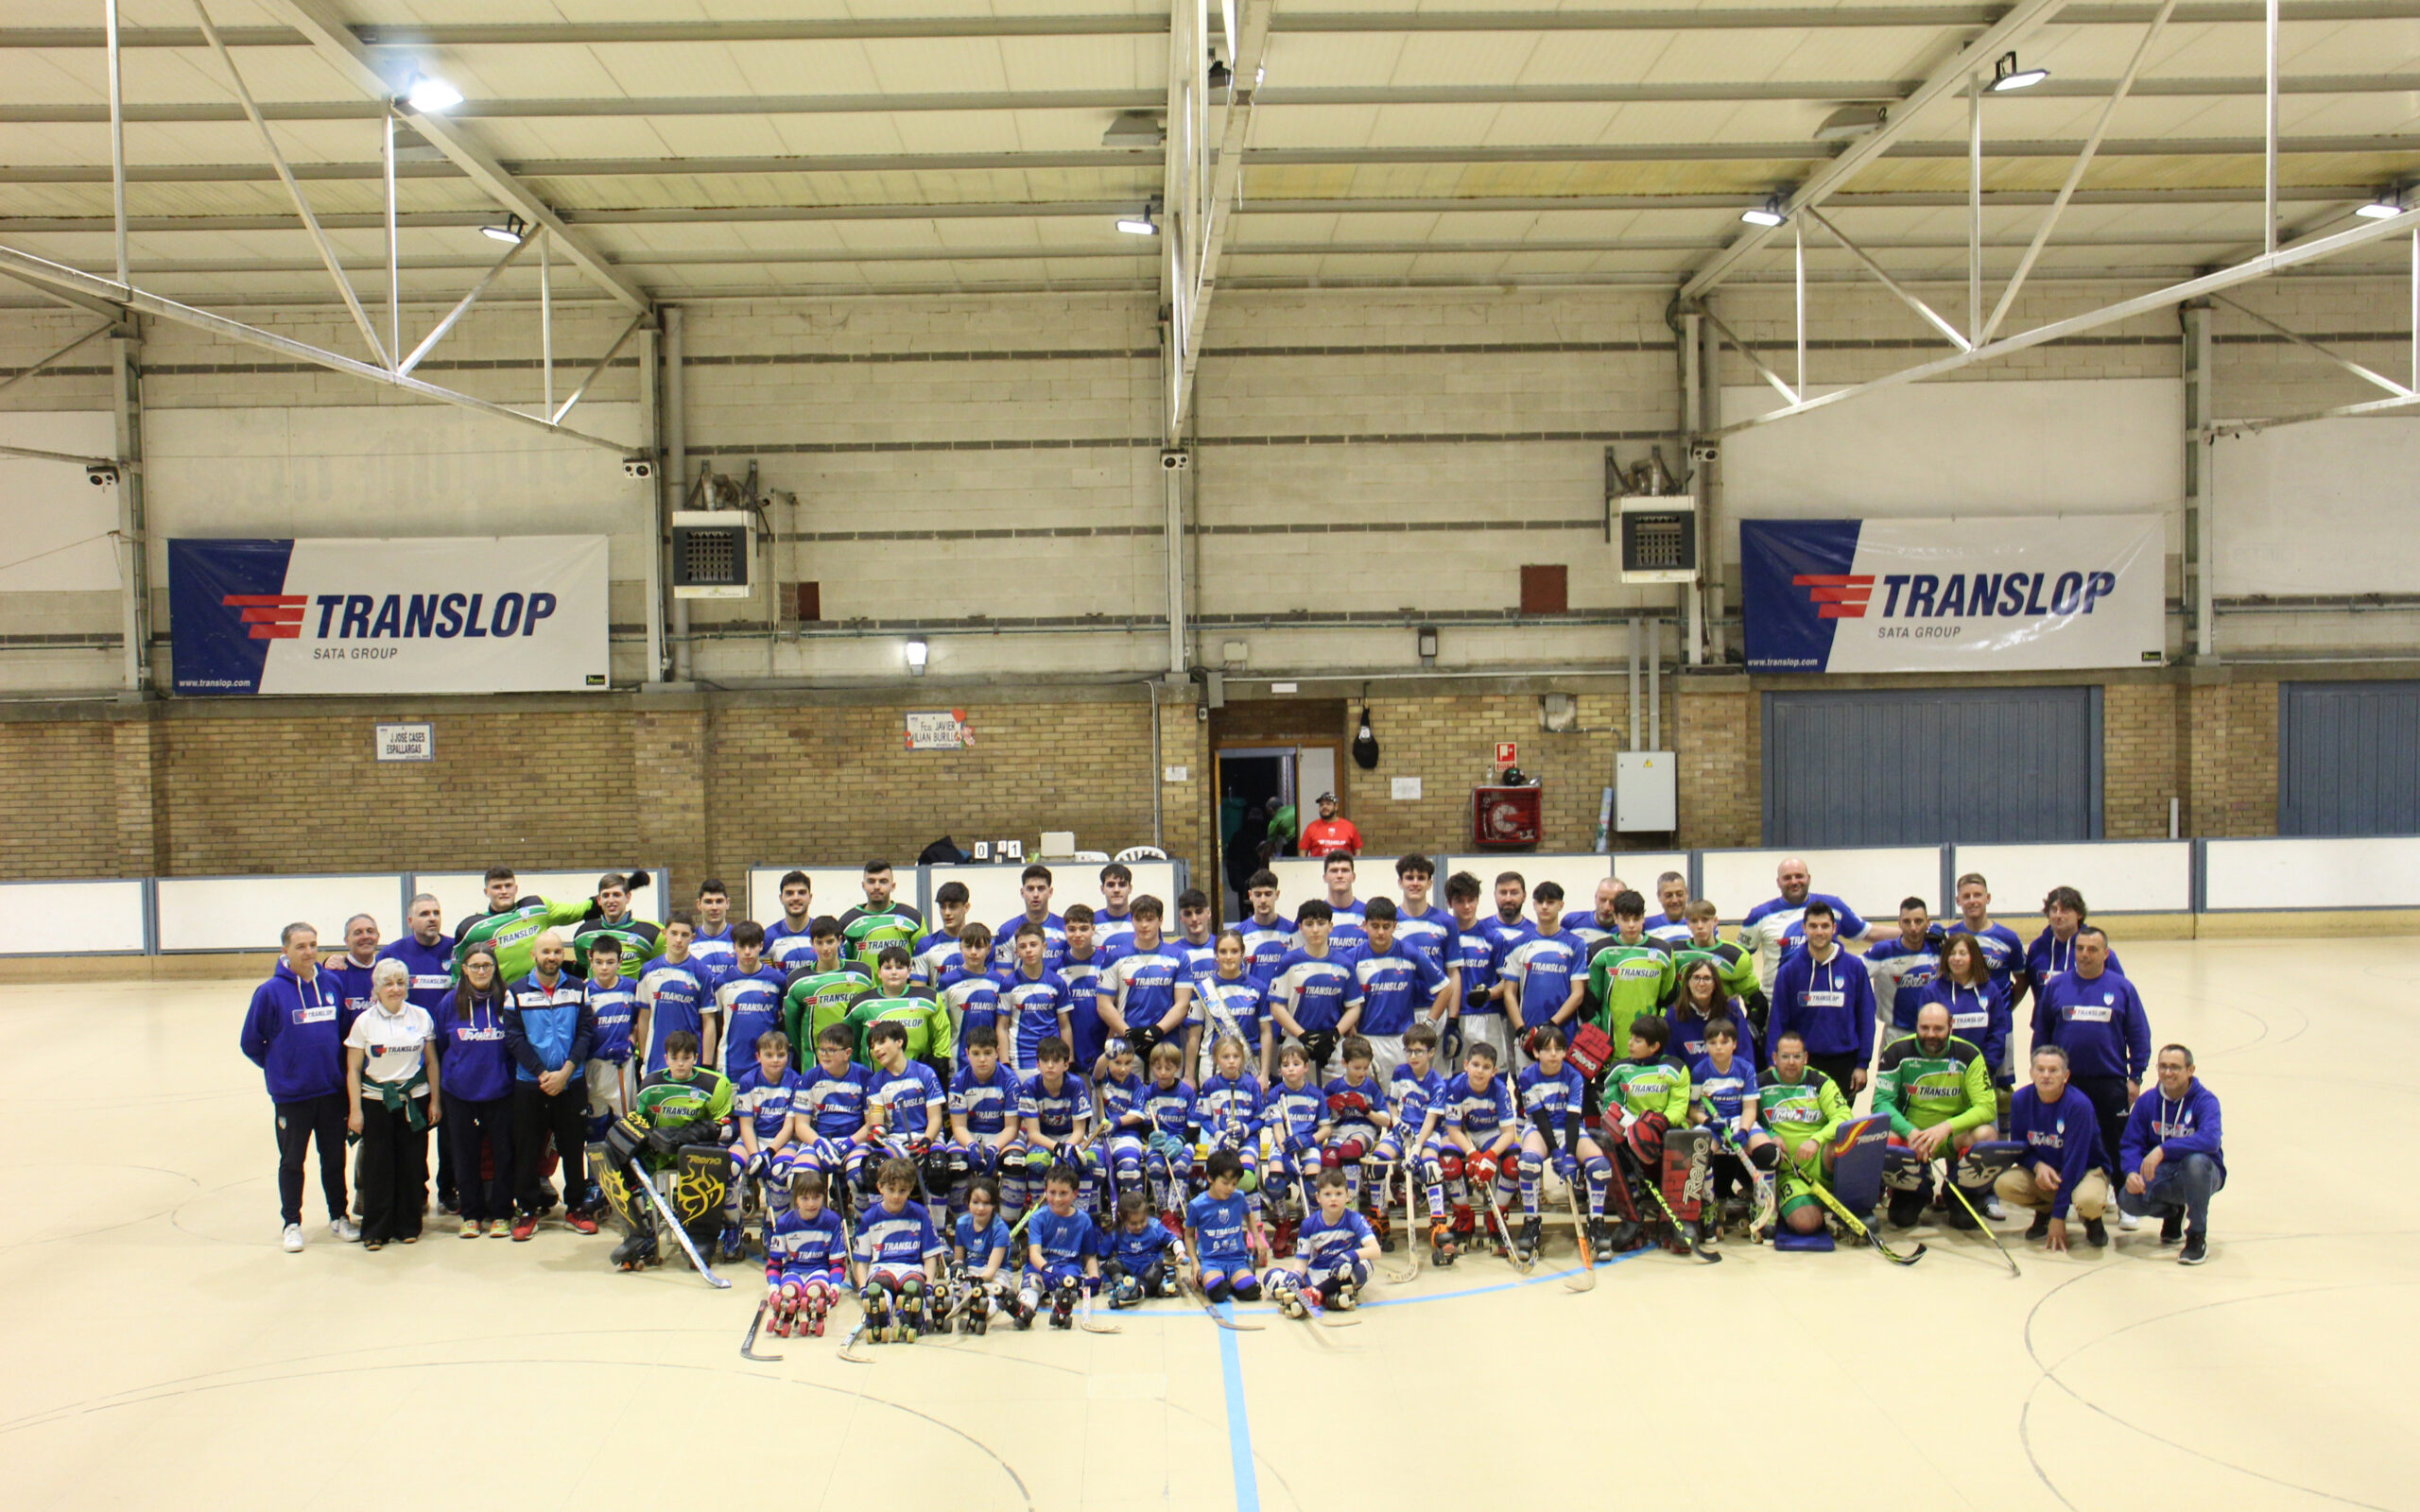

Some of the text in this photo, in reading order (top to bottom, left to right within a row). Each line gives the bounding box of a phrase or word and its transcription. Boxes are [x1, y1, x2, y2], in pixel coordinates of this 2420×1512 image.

[1883, 571, 2116, 617] TRANSLOP
[317, 593, 557, 639] TRANSLOP
[1878, 627, 1961, 638] SATA GROUP
[313, 647, 398, 660] SATA GROUP
[1748, 658, 1818, 667] www.translop.com
[179, 679, 251, 689] www.translop.com
[935, 721, 956, 731] JAVIER
[408, 732, 425, 743] CASES
[977, 844, 985, 856] 0
[1011, 843, 1017, 856] 1
[497, 924, 540, 944] TRANSLOP
[1620, 969, 1660, 978] TRANSLOP
[1305, 986, 1341, 995] TRANSLOP
[1371, 982, 1409, 992] TRANSLOP
[819, 993, 856, 1003] TRANSLO
[1683, 1137, 1709, 1206] Reno
[1779, 1183, 1794, 1200] 13
